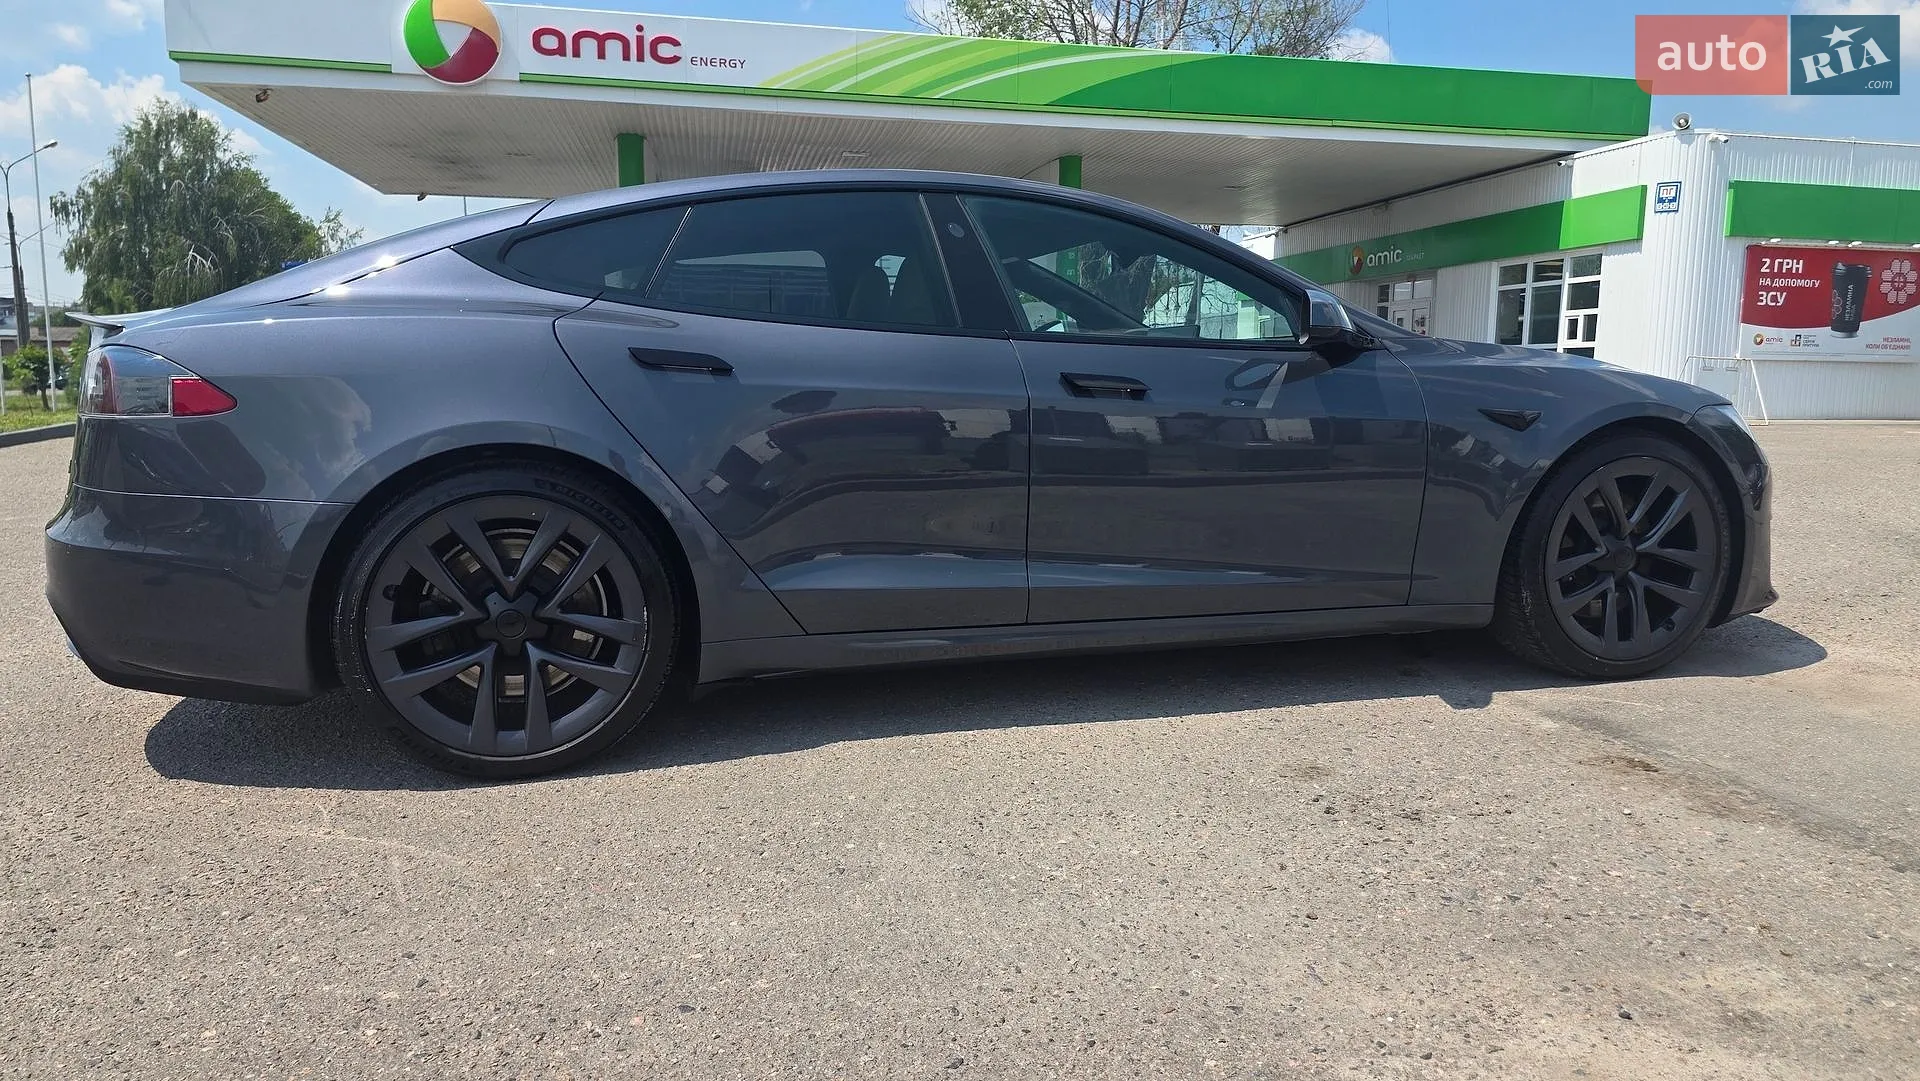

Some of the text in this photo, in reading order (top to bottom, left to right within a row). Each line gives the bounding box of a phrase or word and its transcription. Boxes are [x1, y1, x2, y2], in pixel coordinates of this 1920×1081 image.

[532, 24, 746, 69] amic ENERGY
[1367, 245, 1402, 267] amic
[1760, 258, 1803, 274] 2 ГРН
[1759, 277, 1820, 288] НА ДОПОМОГУ
[1756, 291, 1787, 306] ЗСУ
